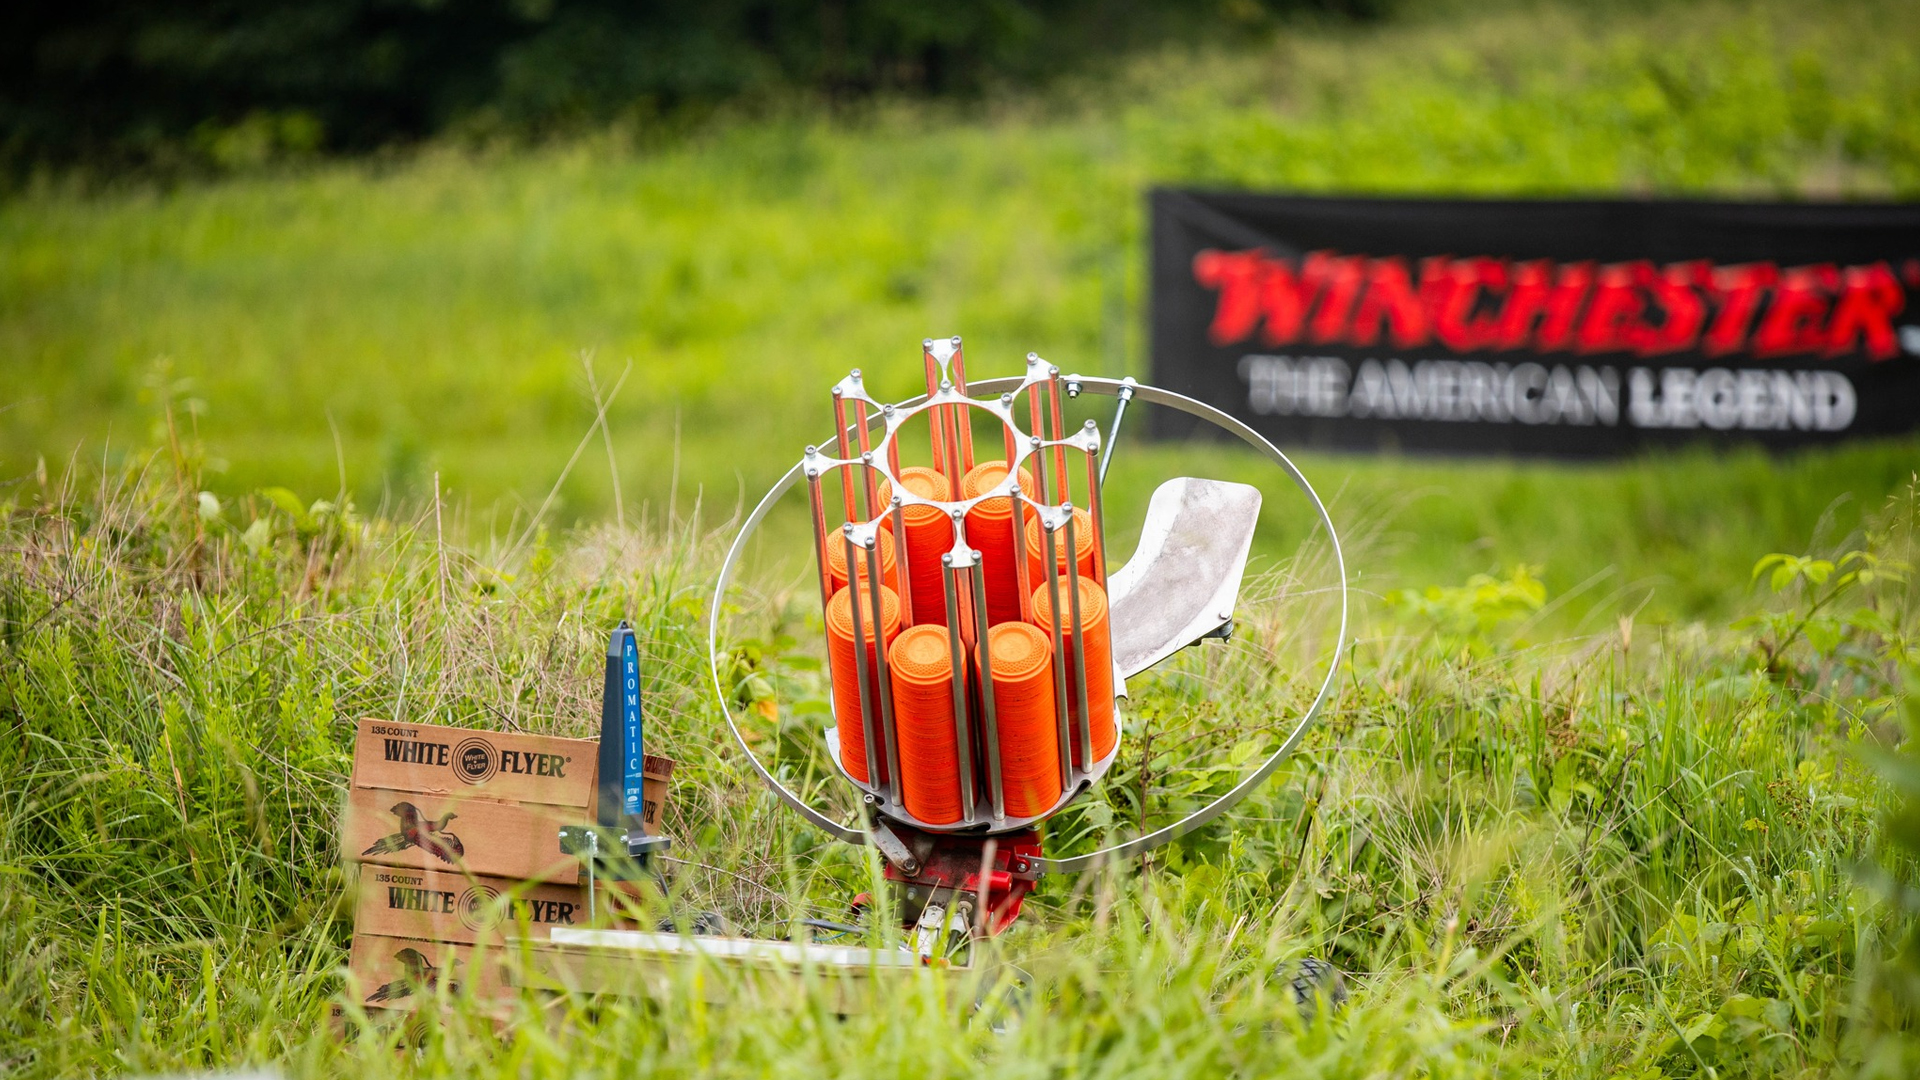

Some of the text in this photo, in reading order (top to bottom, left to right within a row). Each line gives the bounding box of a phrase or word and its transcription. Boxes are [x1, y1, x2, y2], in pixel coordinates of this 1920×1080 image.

[1194, 249, 1903, 359] WINCHESTER
[1240, 355, 1857, 431] THE AMERICAN LEGEND
[626, 644, 637, 770] PROMATIC
[371, 726, 418, 738] 135 COUNT
[384, 738, 450, 766] WHITE
[464, 754, 486, 762] WHITE
[466, 763, 486, 771] FLYER
[375, 874, 423, 886] 135 COUNT
[388, 886, 455, 914] WHITE
